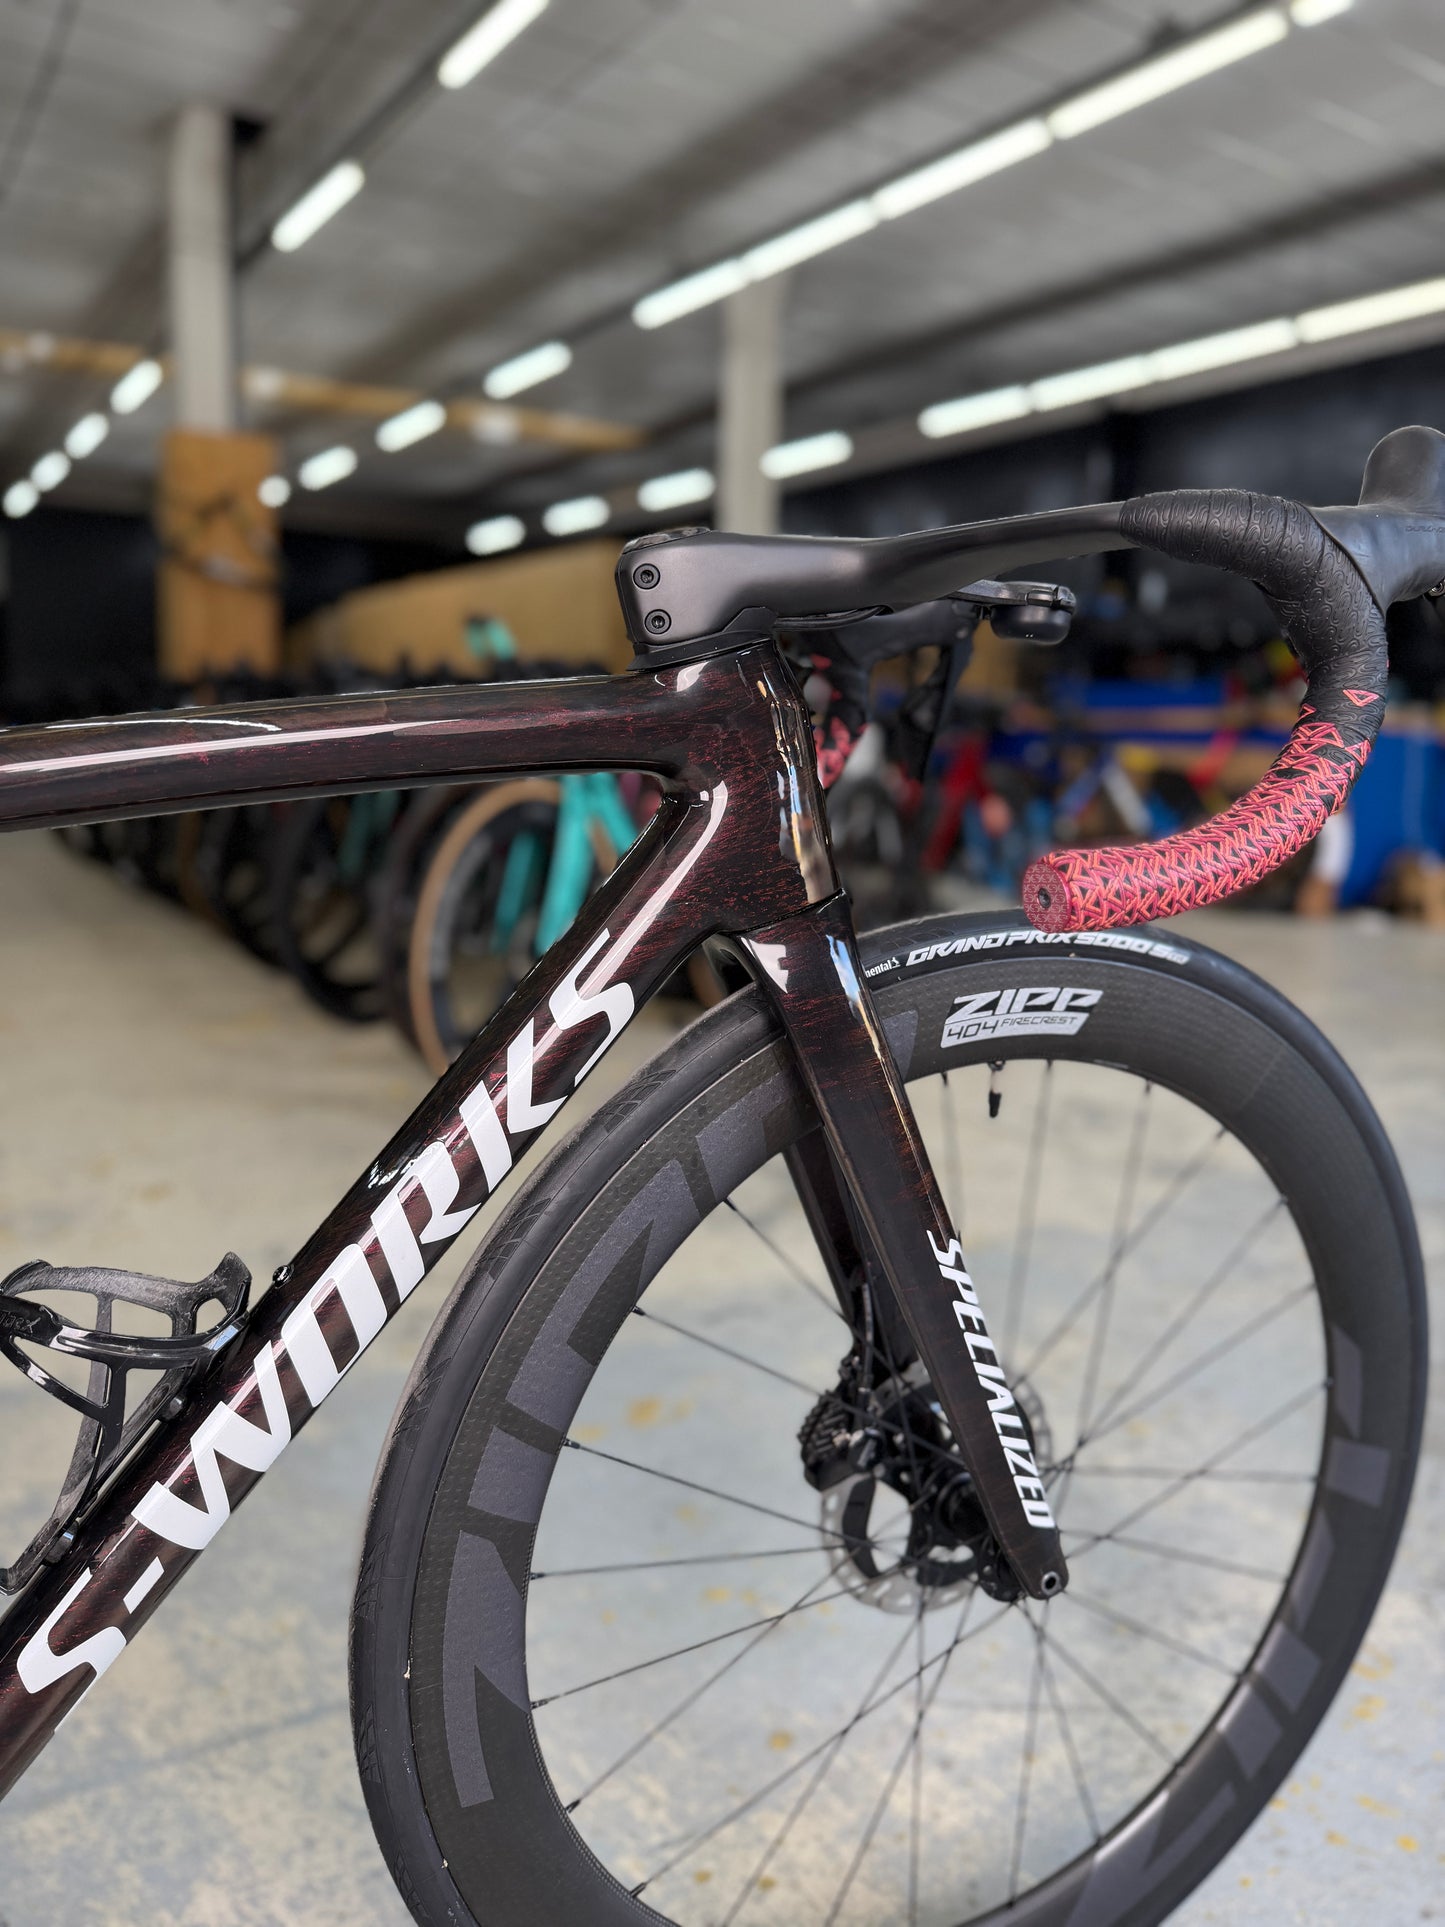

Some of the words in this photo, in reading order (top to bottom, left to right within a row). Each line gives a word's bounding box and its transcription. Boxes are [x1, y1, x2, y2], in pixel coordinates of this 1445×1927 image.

[906, 933, 1007, 966] GRAND
[1005, 931, 1077, 946] PRIX
[1073, 932, 1153, 953] 5000
[945, 987, 1104, 1024] ZIPP
[947, 1020, 1000, 1040] 404
[1001, 1015, 1078, 1028] FIRECREST
[17, 928, 635, 1732] S-WORKS
[926, 1229, 1056, 1529] SPECIALIZED
